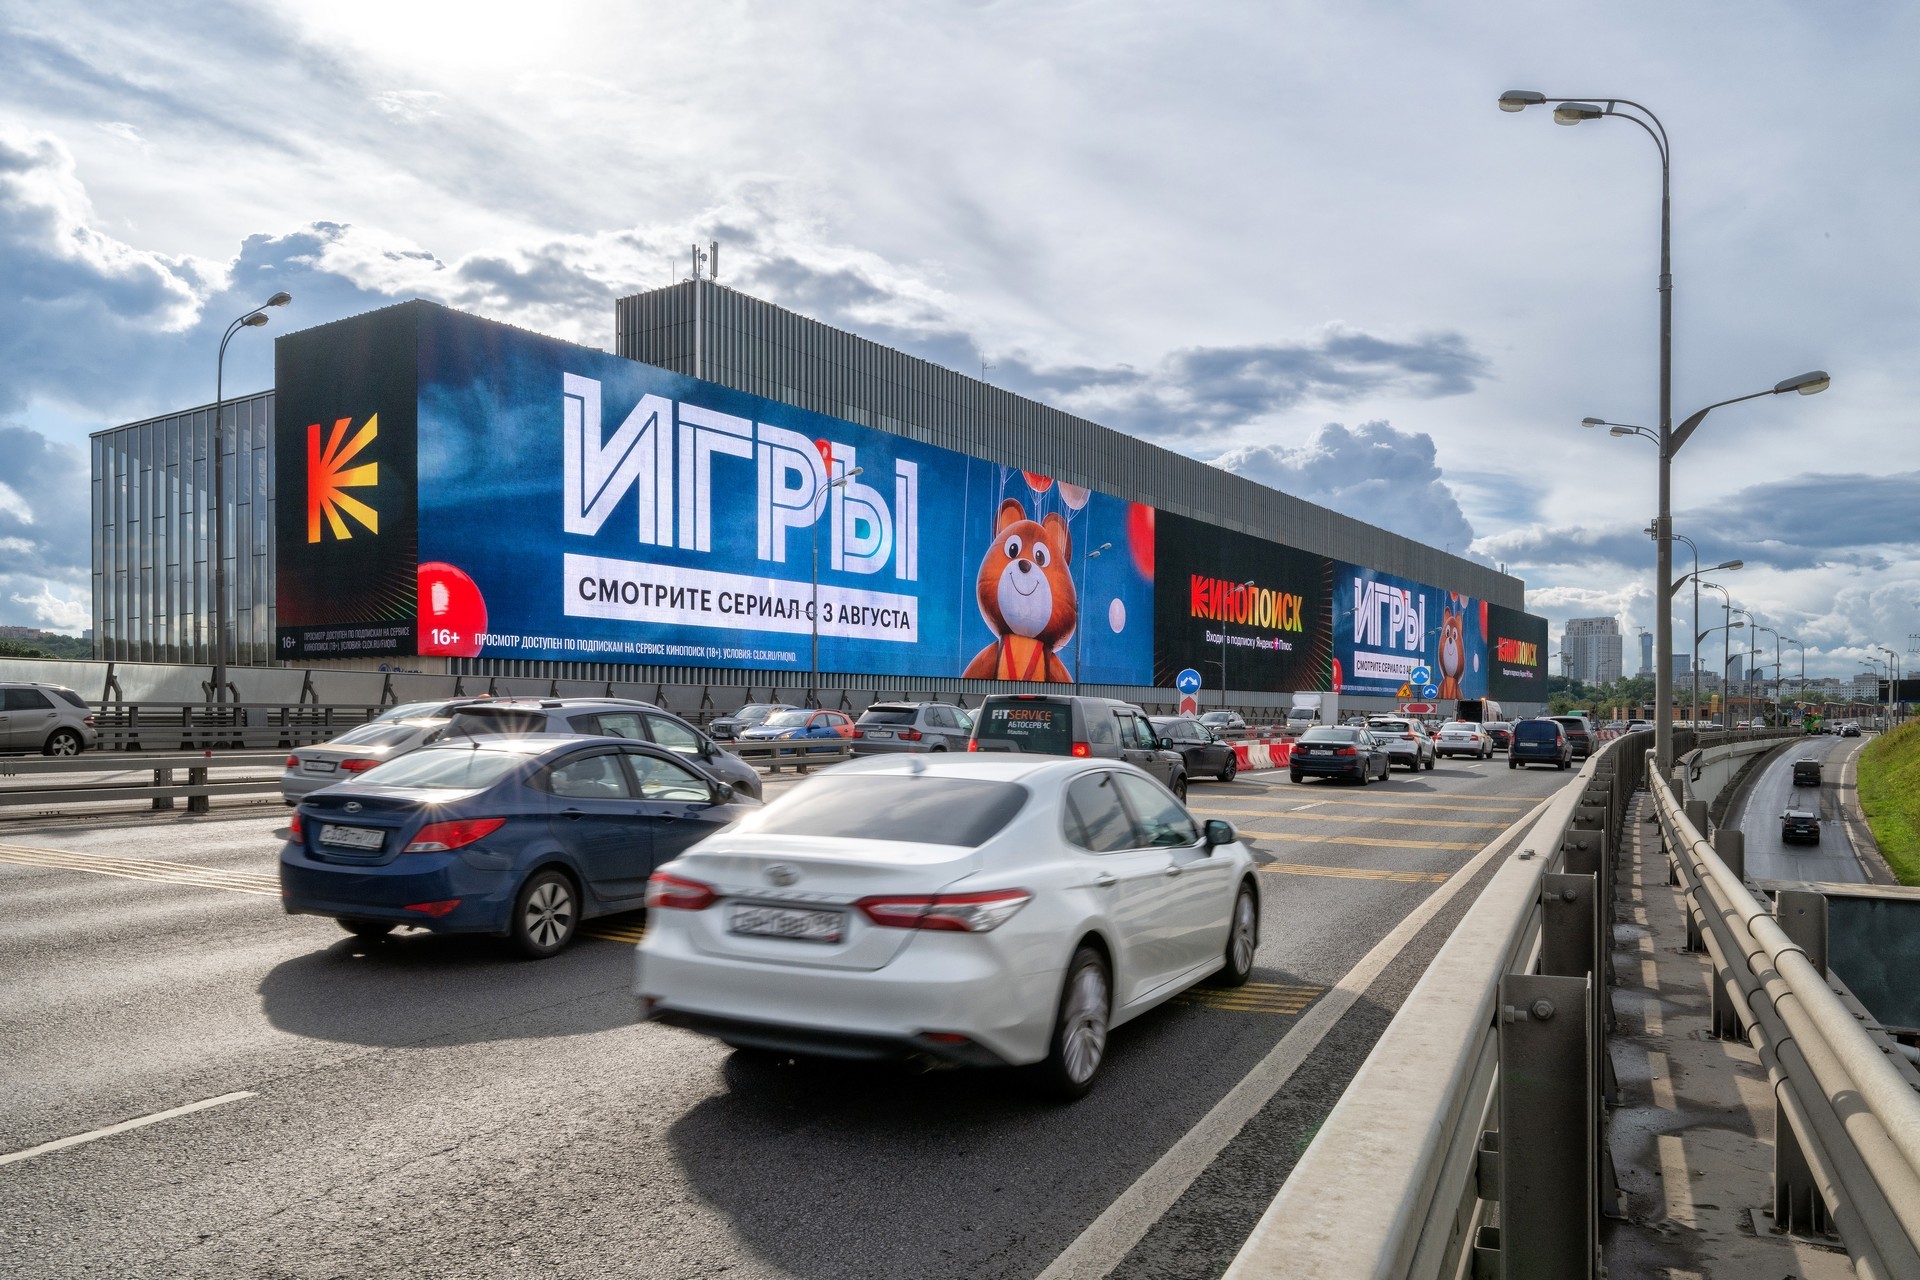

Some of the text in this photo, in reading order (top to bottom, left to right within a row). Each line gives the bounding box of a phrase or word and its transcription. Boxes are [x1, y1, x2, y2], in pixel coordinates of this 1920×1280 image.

[564, 371, 918, 582] ИГРЫ
[578, 576, 712, 614] СМОТРИТЕ
[718, 591, 800, 621] СЕРИАЛ
[823, 602, 833, 623] 3
[838, 604, 911, 630] АВГУСТА
[1191, 573, 1303, 633] КИНОПОИСК
[1354, 577, 1426, 653] ИГРЫ
[282, 636, 296, 649] 16+
[432, 628, 460, 645] 16+
[475, 633, 520, 647] ПРОСМОТР
[521, 636, 563, 650] ДОСТУПЕН
[564, 638, 575, 650] ПО
[577, 639, 624, 653] ПОДПИСКАМ
[624, 642, 635, 653] НА
[635, 642, 665, 655] СЕРВИСЕ
[666, 645, 705, 657] КИНОПОИСК
[723, 648, 752, 660] УСЛОВИЯ:
[1231, 636, 1256, 650] подписку
[1356, 660, 1381, 671] СМОТРИТЕ
